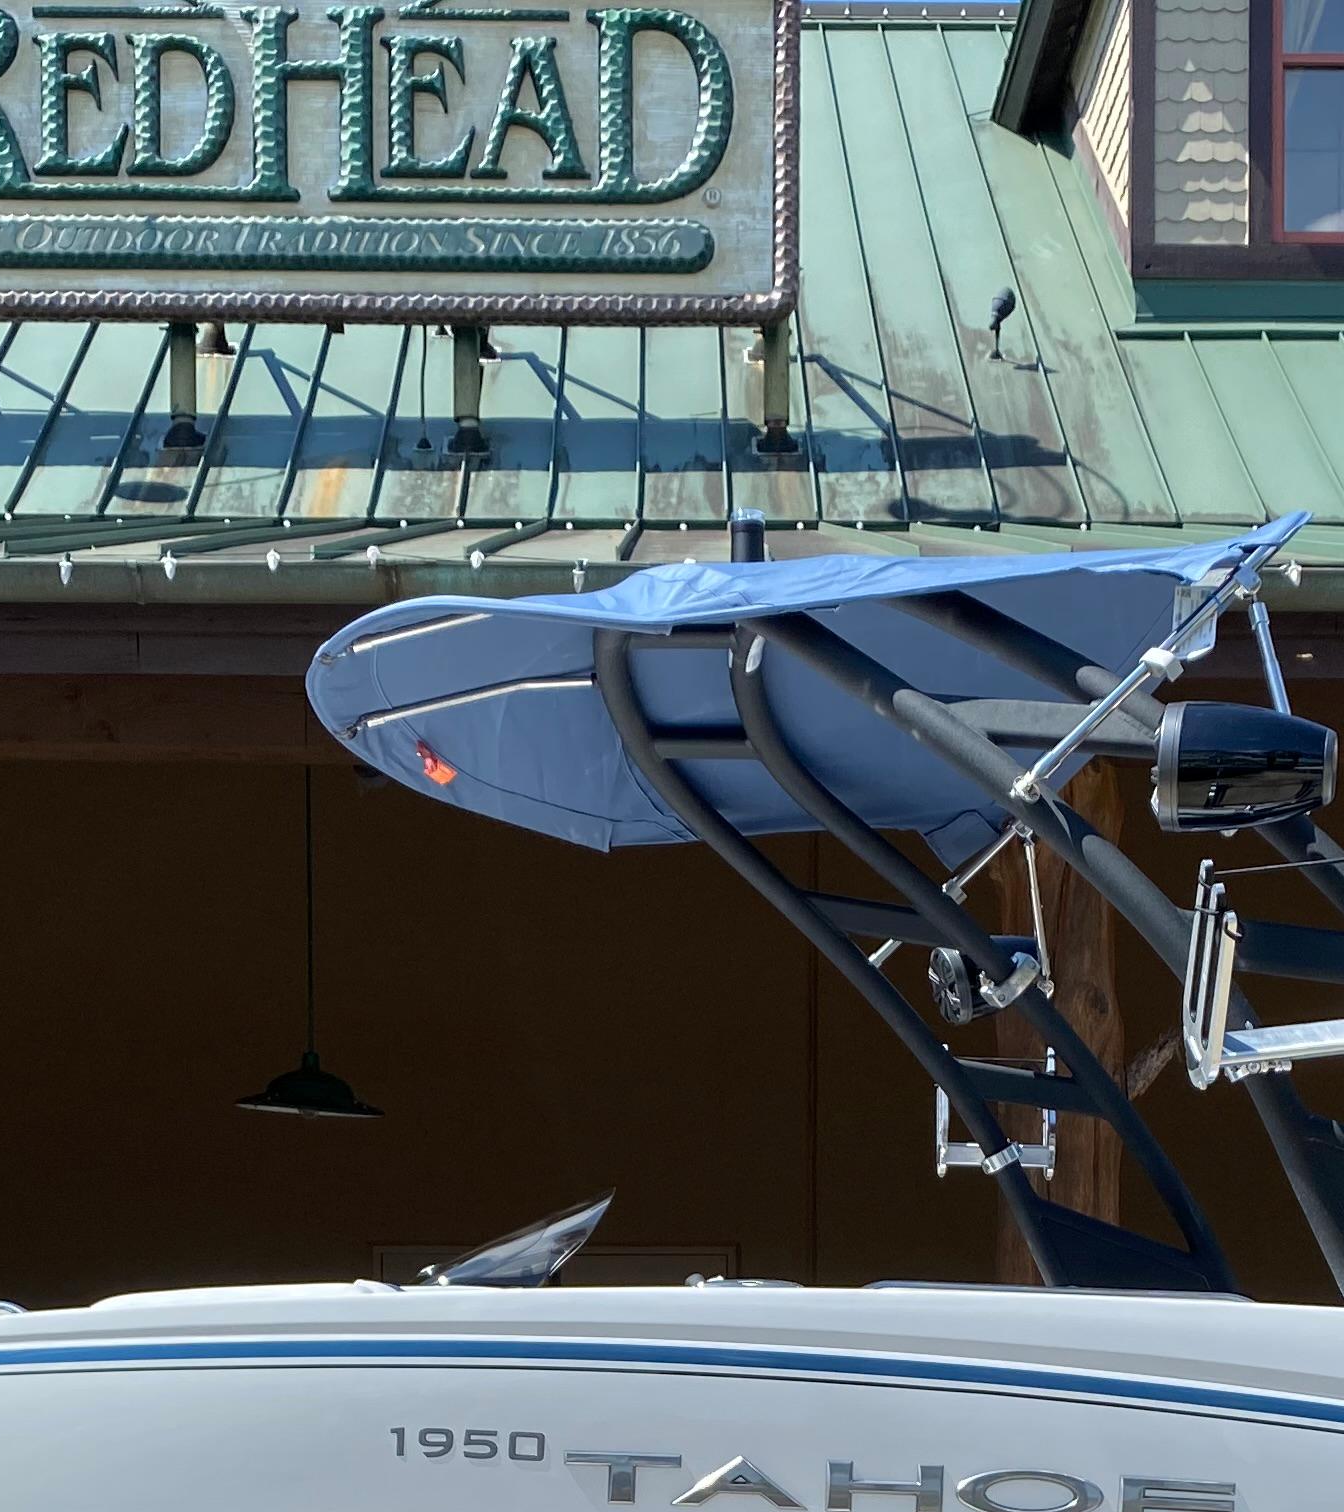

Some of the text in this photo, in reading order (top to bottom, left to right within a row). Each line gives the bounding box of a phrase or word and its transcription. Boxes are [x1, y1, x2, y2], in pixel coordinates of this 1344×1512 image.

[16, 221, 220, 252] OUTDOOR
[231, 222, 449, 255] TRADITION
[457, 225, 584, 257] SINCE
[599, 226, 683, 257] 1856
[390, 1427, 546, 1462] 1950
